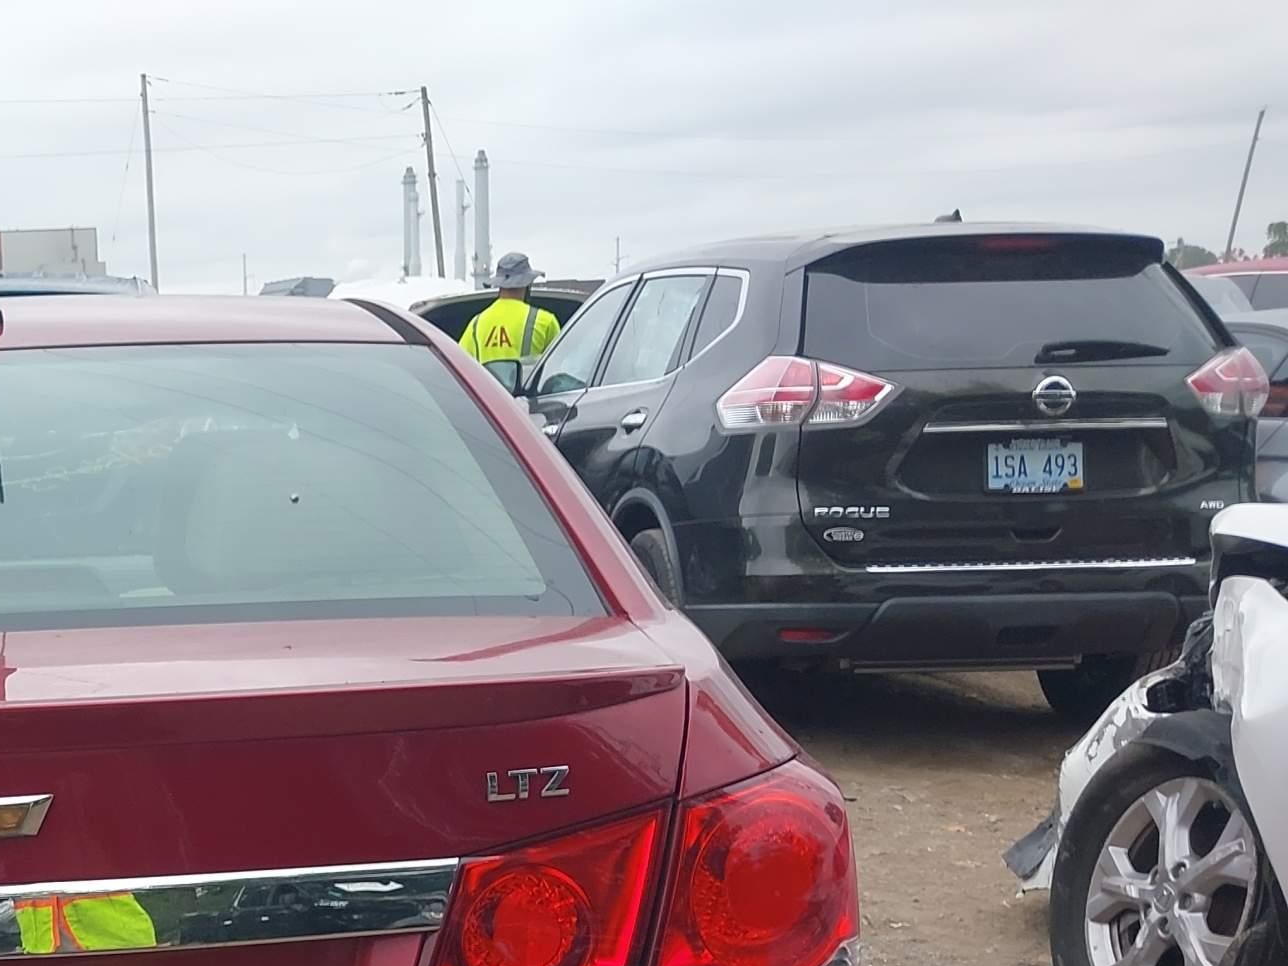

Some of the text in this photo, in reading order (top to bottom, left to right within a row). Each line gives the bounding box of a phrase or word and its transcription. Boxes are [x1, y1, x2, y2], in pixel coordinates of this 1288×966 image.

[992, 453, 1078, 479] 1SA 493
[814, 506, 890, 519] ROGUE
[1200, 500, 1225, 510] AWD
[486, 765, 570, 803] LTZ
